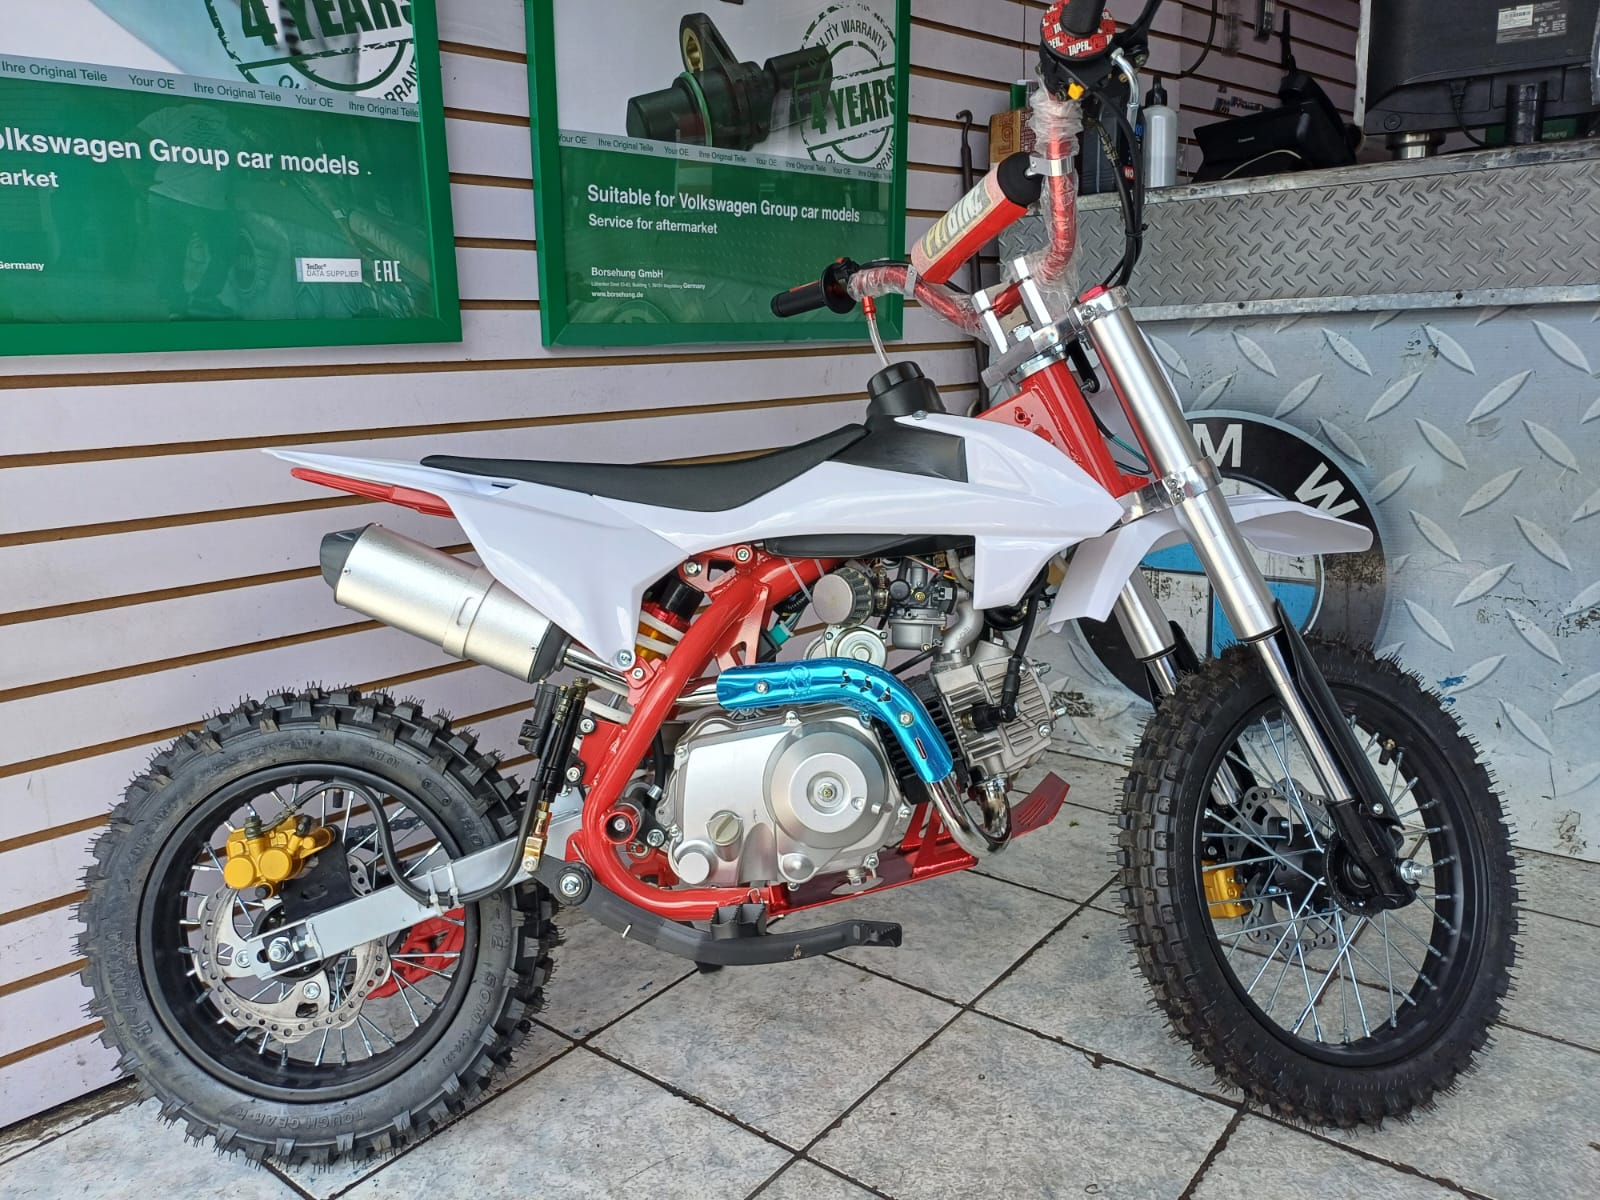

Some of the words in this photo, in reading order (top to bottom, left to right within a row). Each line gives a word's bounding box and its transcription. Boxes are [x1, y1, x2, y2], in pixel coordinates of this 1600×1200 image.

[241, 0, 277, 46] 4
[841, 19, 888, 52] WARRANTY
[2, 61, 26, 74] Ihre
[29, 64, 77, 79] Original
[80, 69, 108, 82] Teile
[128, 74, 155, 87] Your
[157, 78, 176, 89] OE
[194, 83, 215, 95] Ihre
[217, 86, 256, 100] Original
[259, 90, 281, 102] Teile
[296, 95, 317, 106] Your
[319, 98, 334, 108] OE
[349, 101, 365, 112] Ihre
[367, 104, 399, 116] Original
[0, 127, 141, 163] lkswagen
[149, 138, 229, 171] Group
[237, 151, 273, 169] car
[280, 153, 360, 175] models
[576, 136, 587, 144] OE
[598, 138, 611, 148] Ihre
[613, 140, 638, 151] Original
[664, 146, 678, 155] Your
[679, 148, 689, 156] OE
[587, 184, 651, 206] Suitable
[655, 190, 675, 207] for
[679, 192, 757, 217] Volkswagen
[760, 200, 798, 221] Group
[801, 206, 818, 219] car
[822, 207, 860, 223] models
[589, 213, 633, 229] Service
[637, 217, 653, 230] for
[656, 219, 718, 234] aftermarket
[326, 270, 359, 278] SUPPLIER
[591, 267, 636, 279] Borsehung
[638, 269, 664, 278] GmbH
